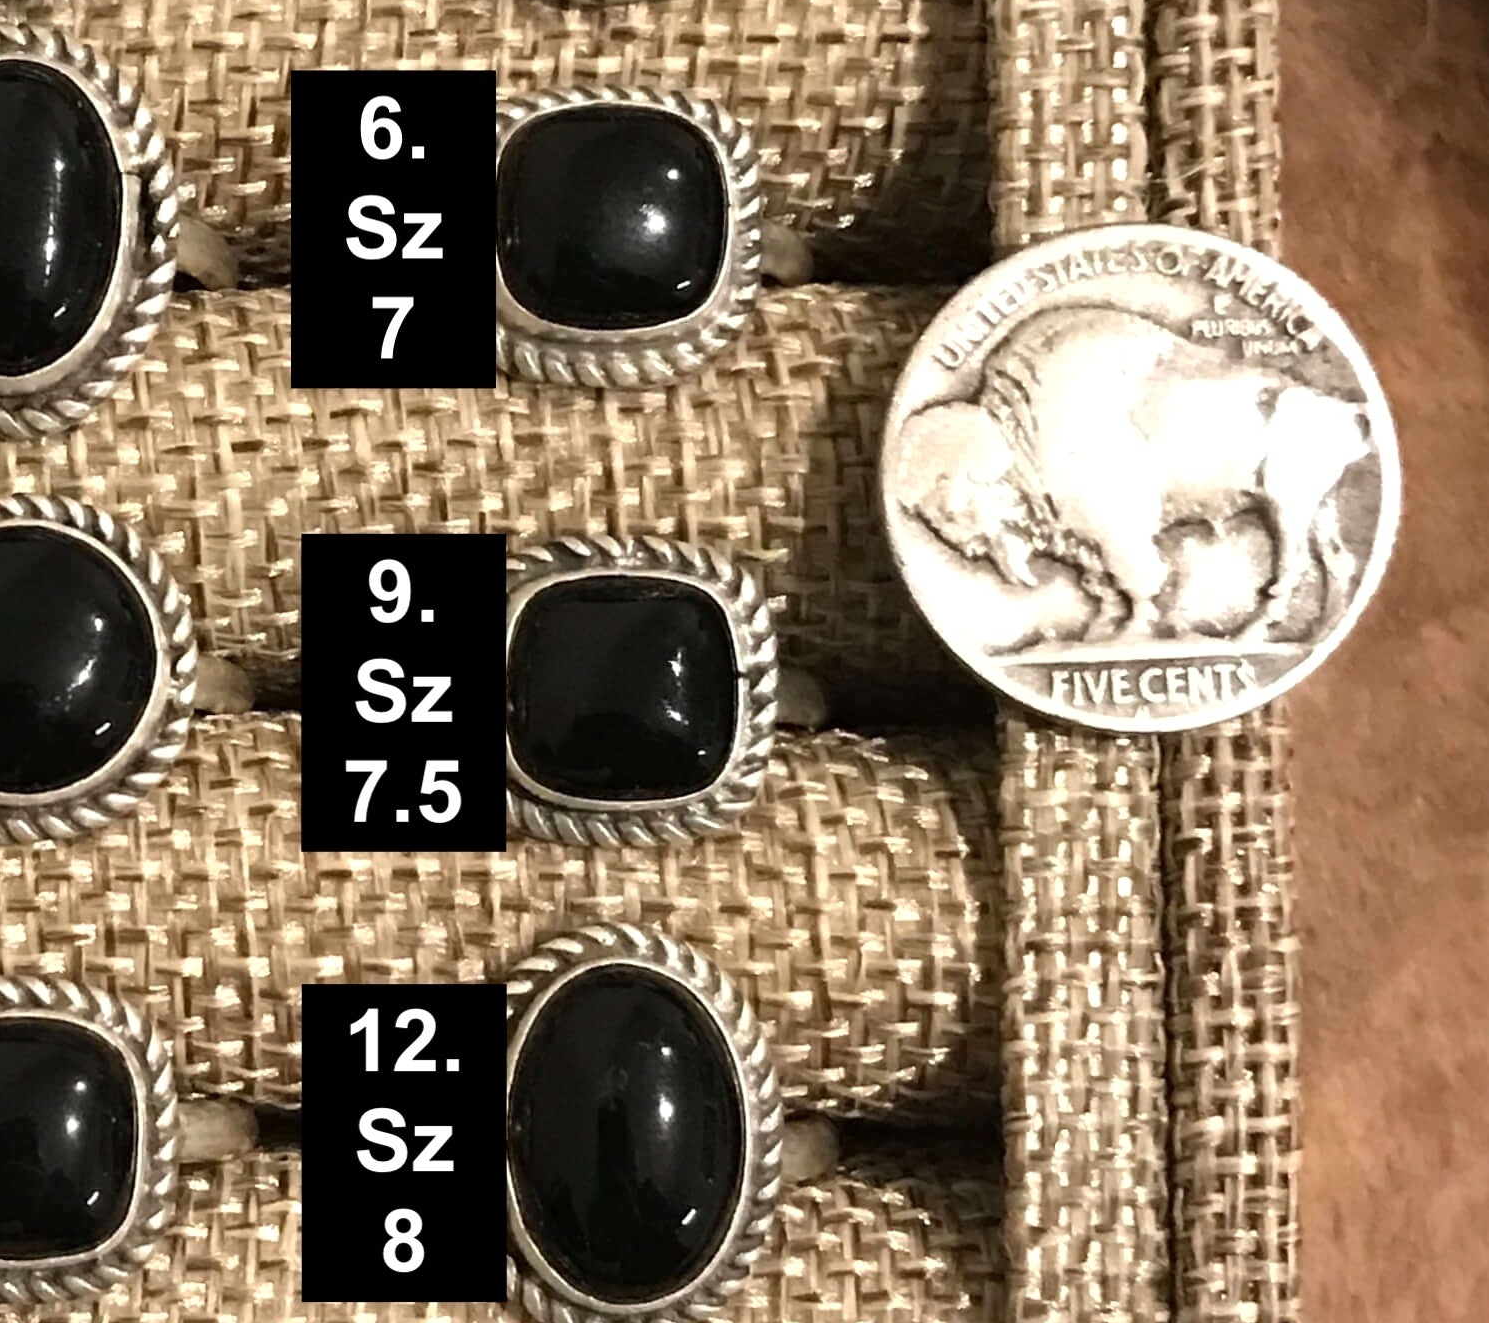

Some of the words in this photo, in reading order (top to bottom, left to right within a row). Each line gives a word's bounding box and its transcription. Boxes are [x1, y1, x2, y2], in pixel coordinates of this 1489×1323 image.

[932, 278, 1035, 370] UNITED
[1032, 246, 1149, 294] STATES
[1155, 245, 1207, 277] OF
[1204, 253, 1325, 352] AMERICA
[1050, 668, 1136, 706] FIVE
[1138, 657, 1259, 705] CENTS
